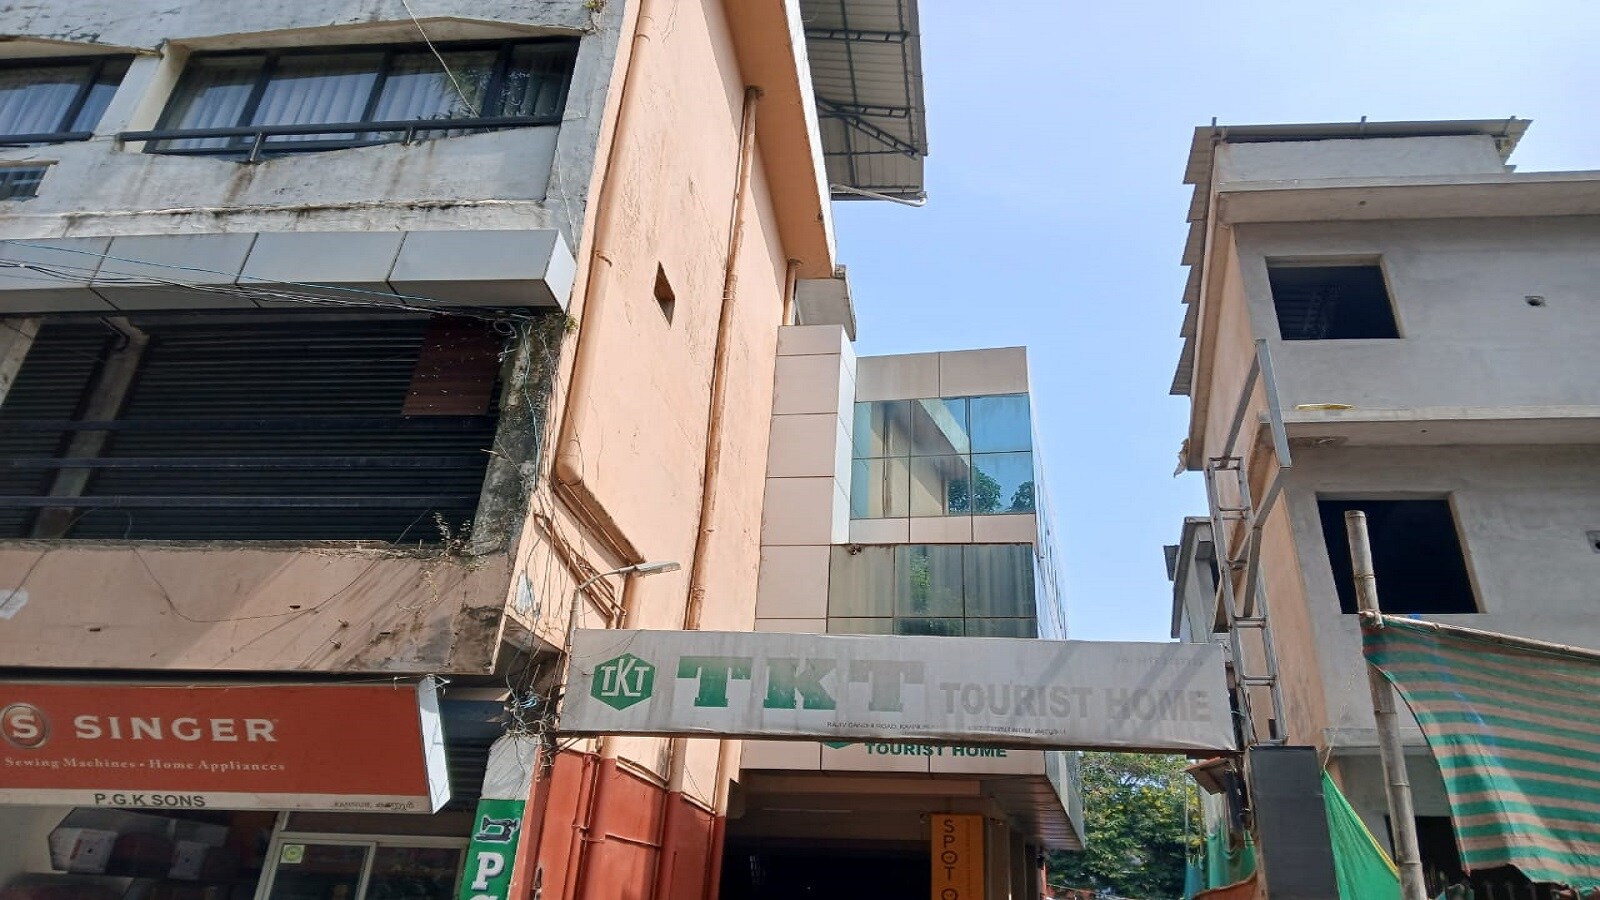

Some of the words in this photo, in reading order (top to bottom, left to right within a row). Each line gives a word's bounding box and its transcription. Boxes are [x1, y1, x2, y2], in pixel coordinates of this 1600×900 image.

[600, 658, 650, 697] TKT
[677, 656, 924, 712] TKT
[940, 682, 1093, 718] TOURIST
[1101, 687, 1211, 722] HOME
[10, 714, 38, 739] S
[73, 714, 278, 742] SINGER
[864, 742, 943, 757] TOURIST
[952, 745, 1008, 758] HOME
[4, 757, 60, 770] Sewing
[63, 758, 136, 769] Machines
[149, 759, 194, 770] Home
[199, 760, 286, 773] Appliances
[94, 793, 146, 806] P.G.K
[151, 794, 206, 808] SONS
[941, 818, 958, 881] SPOT
